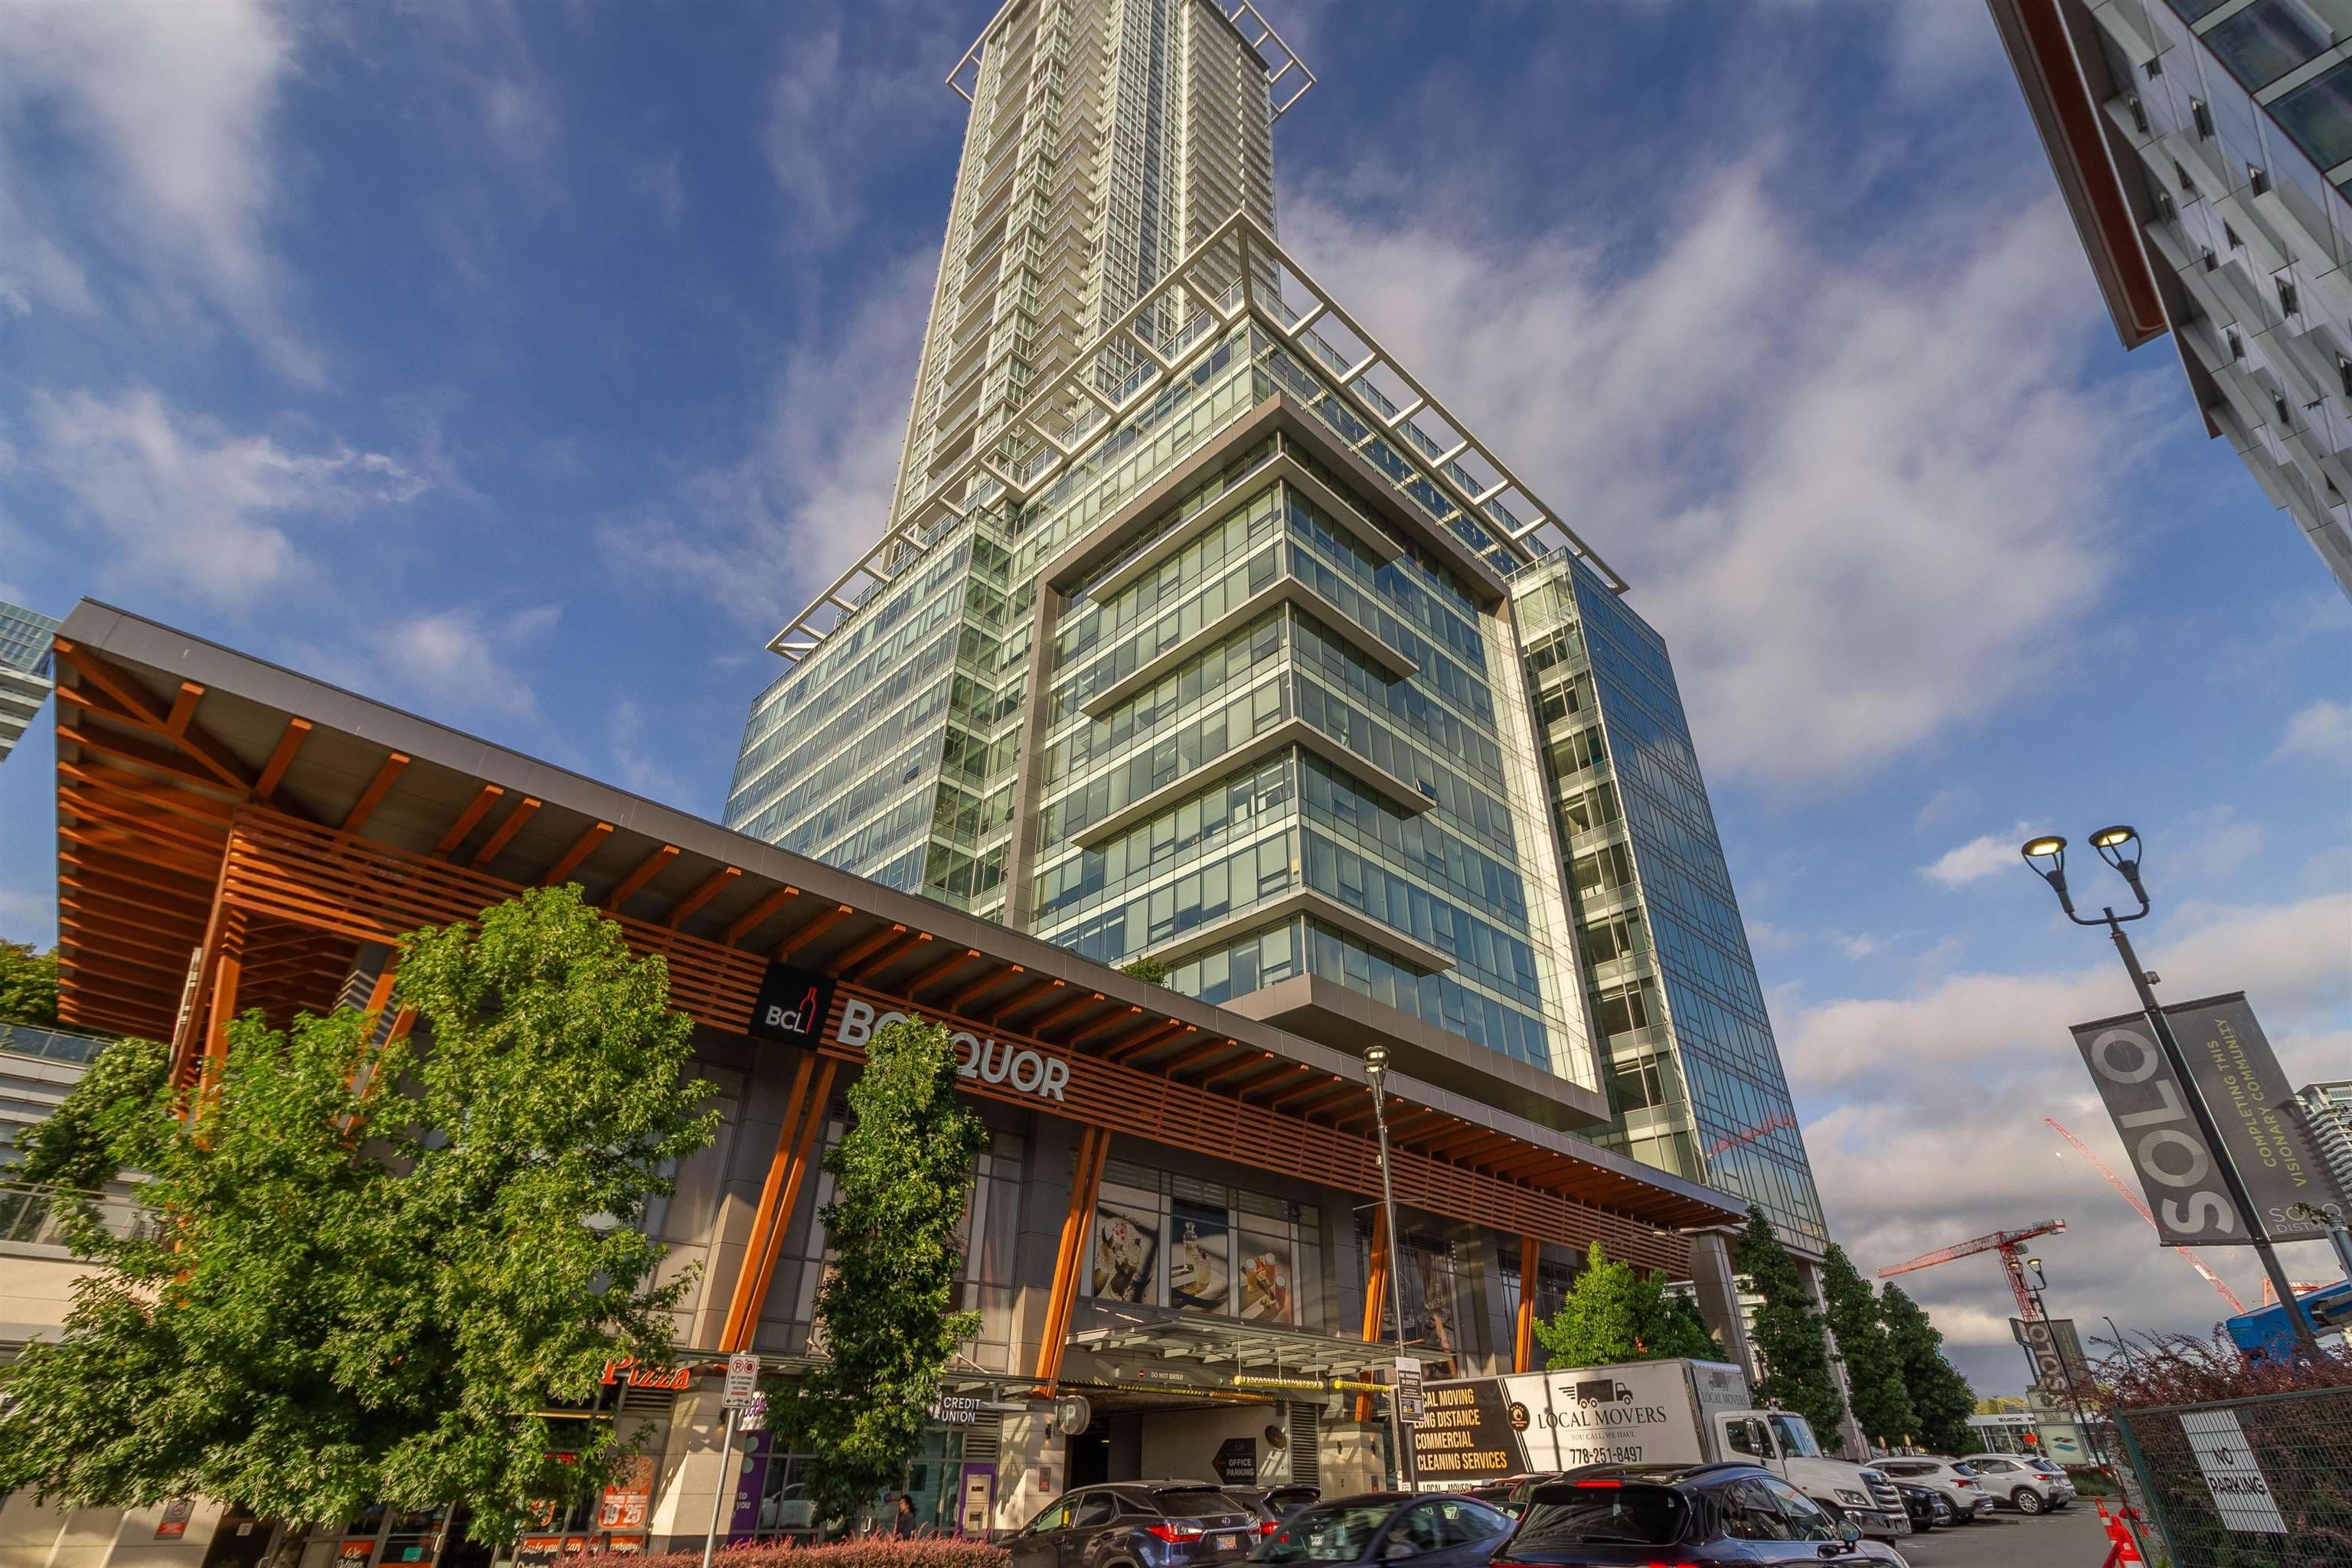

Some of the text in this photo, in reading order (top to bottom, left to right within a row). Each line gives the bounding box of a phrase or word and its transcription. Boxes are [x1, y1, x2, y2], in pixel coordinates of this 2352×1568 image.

[766, 1004, 805, 1033] BCL
[949, 1031, 1070, 1102] QUOR
[2207, 1040, 2277, 1168] COMPLETING THIS
[2213, 1018, 2308, 1187] VISIONARY COMMUNITY
[2091, 1029, 2234, 1234] SOLO
[2269, 1203, 2341, 1223] SOO
[2276, 1222, 2323, 1233] DISTR
[597, 1355, 690, 1390] Pizza
[943, 1396, 981, 1410] CREDIT
[1423, 1389, 1474, 1407] CAL MOVING
[1701, 1392, 1747, 1405] LOCAL MOVERS
[942, 1410, 975, 1422] UNION
[1437, 1410, 1481, 1427] DISTANCE
[1537, 1406, 1667, 1429] LOCAL MOVERS
[1415, 1431, 1474, 1449] COMMERCIAL
[1417, 1452, 1507, 1471] CLEANING SERVICES
[1570, 1446, 1642, 1464] 778-251-8497
[2212, 1446, 2233, 1465] NO
[2208, 1475, 2265, 1495] PARKING
[739, 1491, 748, 1500] to
[736, 1501, 751, 1511] you
